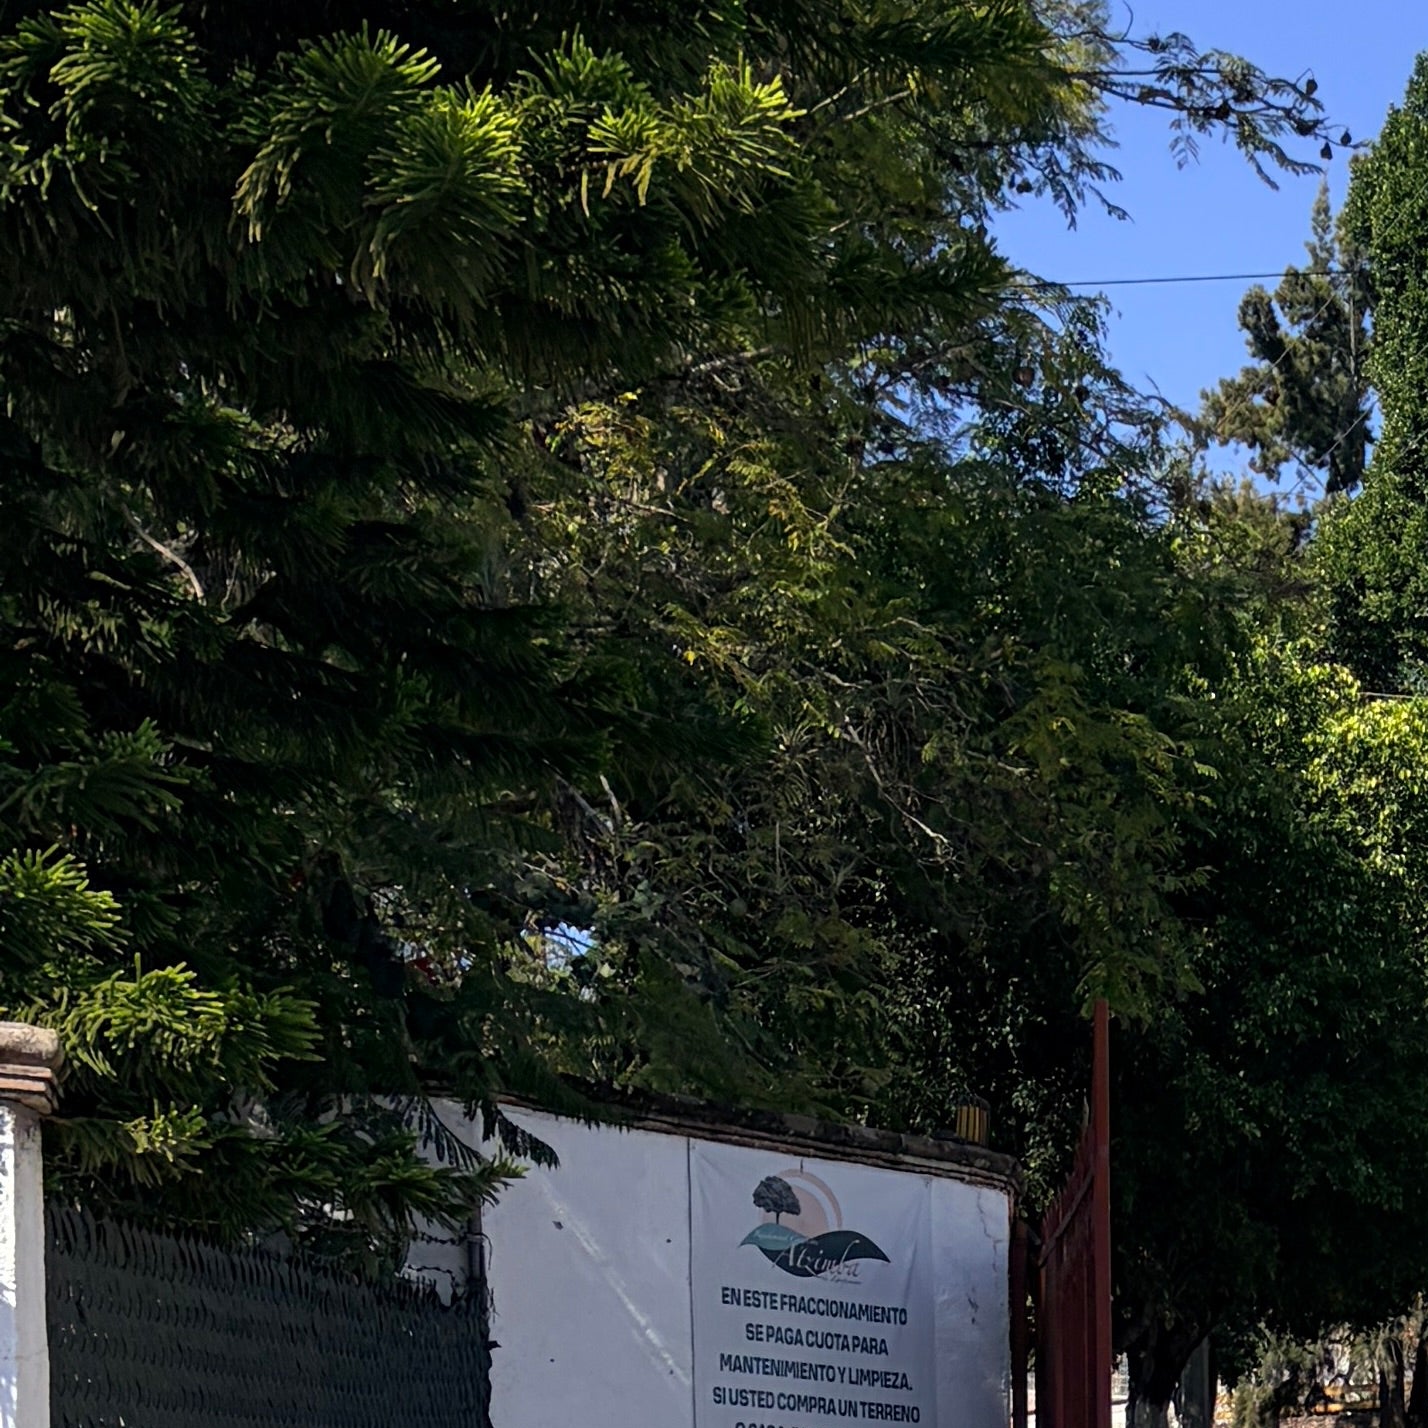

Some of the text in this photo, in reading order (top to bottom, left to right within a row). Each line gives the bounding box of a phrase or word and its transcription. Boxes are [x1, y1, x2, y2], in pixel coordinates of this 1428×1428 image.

[721, 1286, 908, 1325] EN ESTE FRACCIONAMIENTO
[745, 1323, 889, 1356] SE PAGA CUOTA PARA
[719, 1353, 913, 1391] MANTENIMIENTO Y LIMPIEZA.
[713, 1387, 920, 1424] SI USTED COMPRA UN TERRENO
